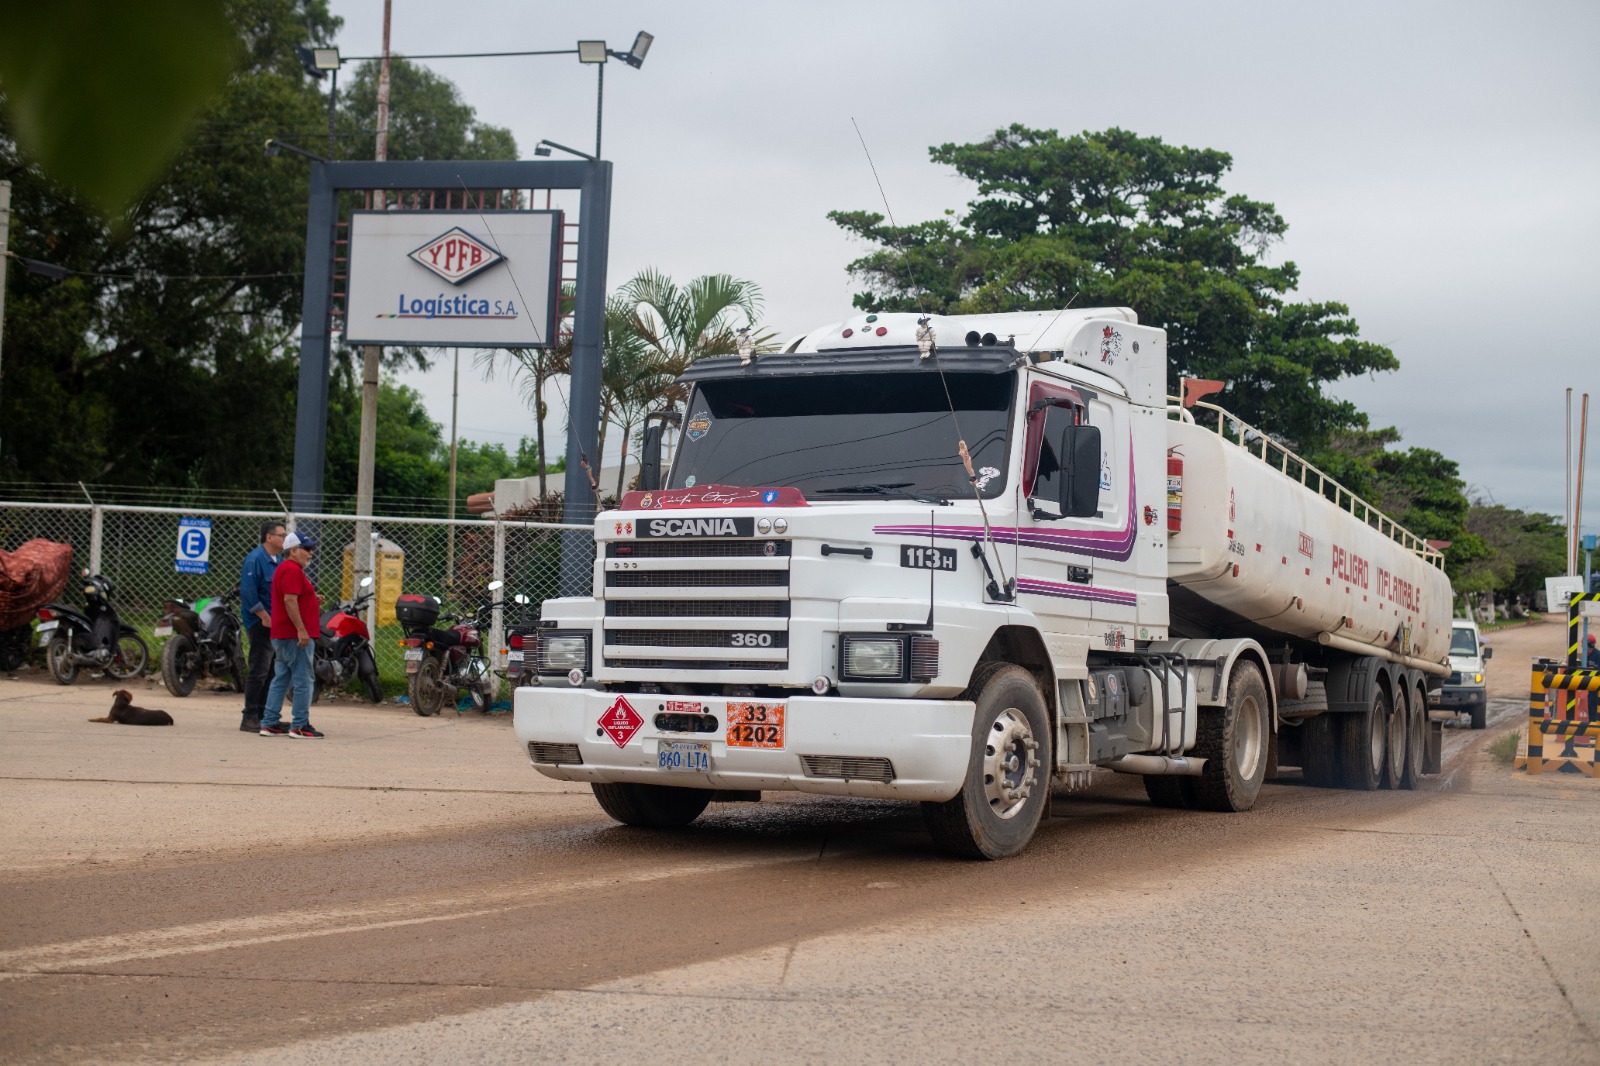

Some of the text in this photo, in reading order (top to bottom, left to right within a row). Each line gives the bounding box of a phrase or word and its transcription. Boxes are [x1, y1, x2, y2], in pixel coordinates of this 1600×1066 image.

[429, 239, 482, 272] YPFB
[399, 293, 518, 319] Logística S.A.
[650, 519, 738, 537] SCANIA
[187, 533, 201, 554] E
[1332, 544, 1369, 590] PELIGRO
[1377, 566, 1421, 614] INFLAMABLE
[731, 633, 772, 647] 360
[744, 705, 767, 722] 33
[617, 731, 624, 740] 3
[732, 726, 778, 743] 1202
[659, 751, 708, 768] 860 LTA
